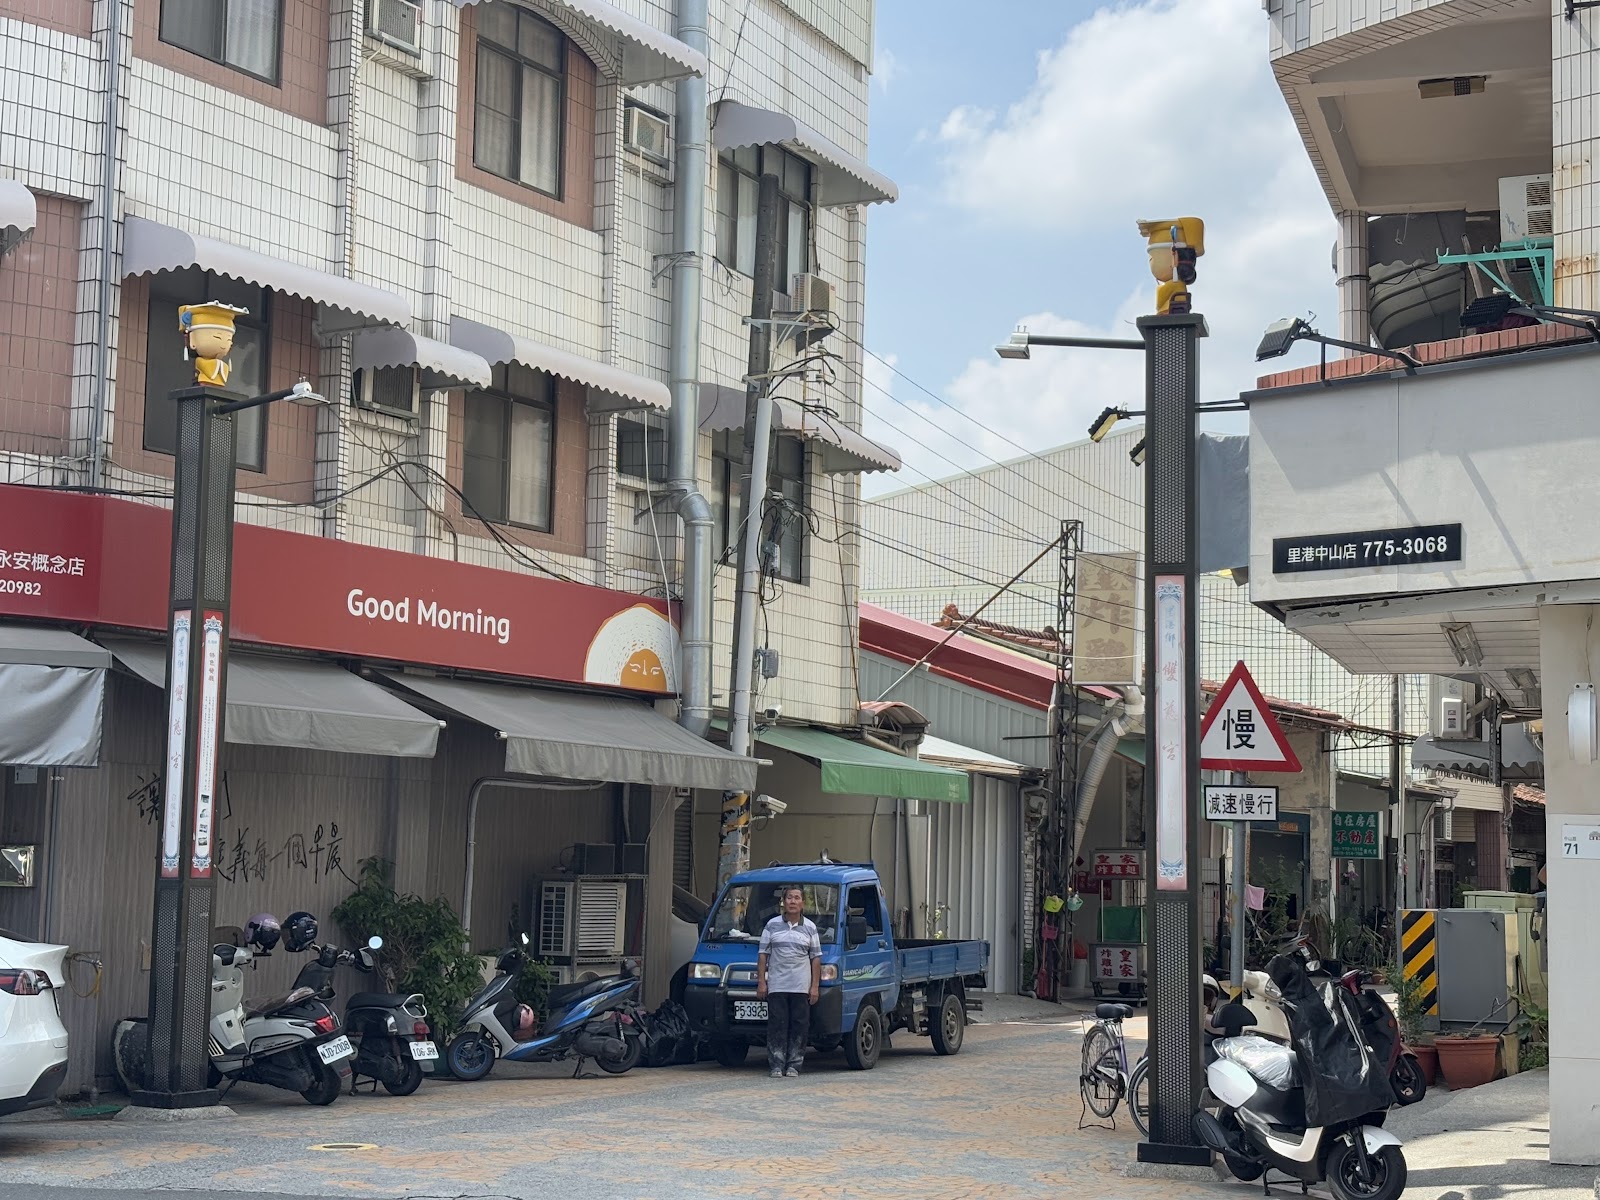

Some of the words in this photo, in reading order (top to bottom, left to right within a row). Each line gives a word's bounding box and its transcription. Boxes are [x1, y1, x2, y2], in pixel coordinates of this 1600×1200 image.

[1287, 543, 1357, 564] 里港中山店
[1362, 535, 1448, 558] 775-3068
[0, 549, 86, 577] 永安概念店
[347, 588, 410, 624] Good
[417, 598, 510, 644] Morning
[1221, 708, 1256, 750] 慢
[1208, 792, 1273, 815] 減速慢行
[1333, 813, 1376, 828] 自在房屋
[1335, 829, 1376, 845] 不動產
[1564, 842, 1579, 855] 71
[1096, 853, 1139, 865] 皇家
[1118, 948, 1135, 978] 皇家
[320, 1040, 351, 1060] NJD-2008
